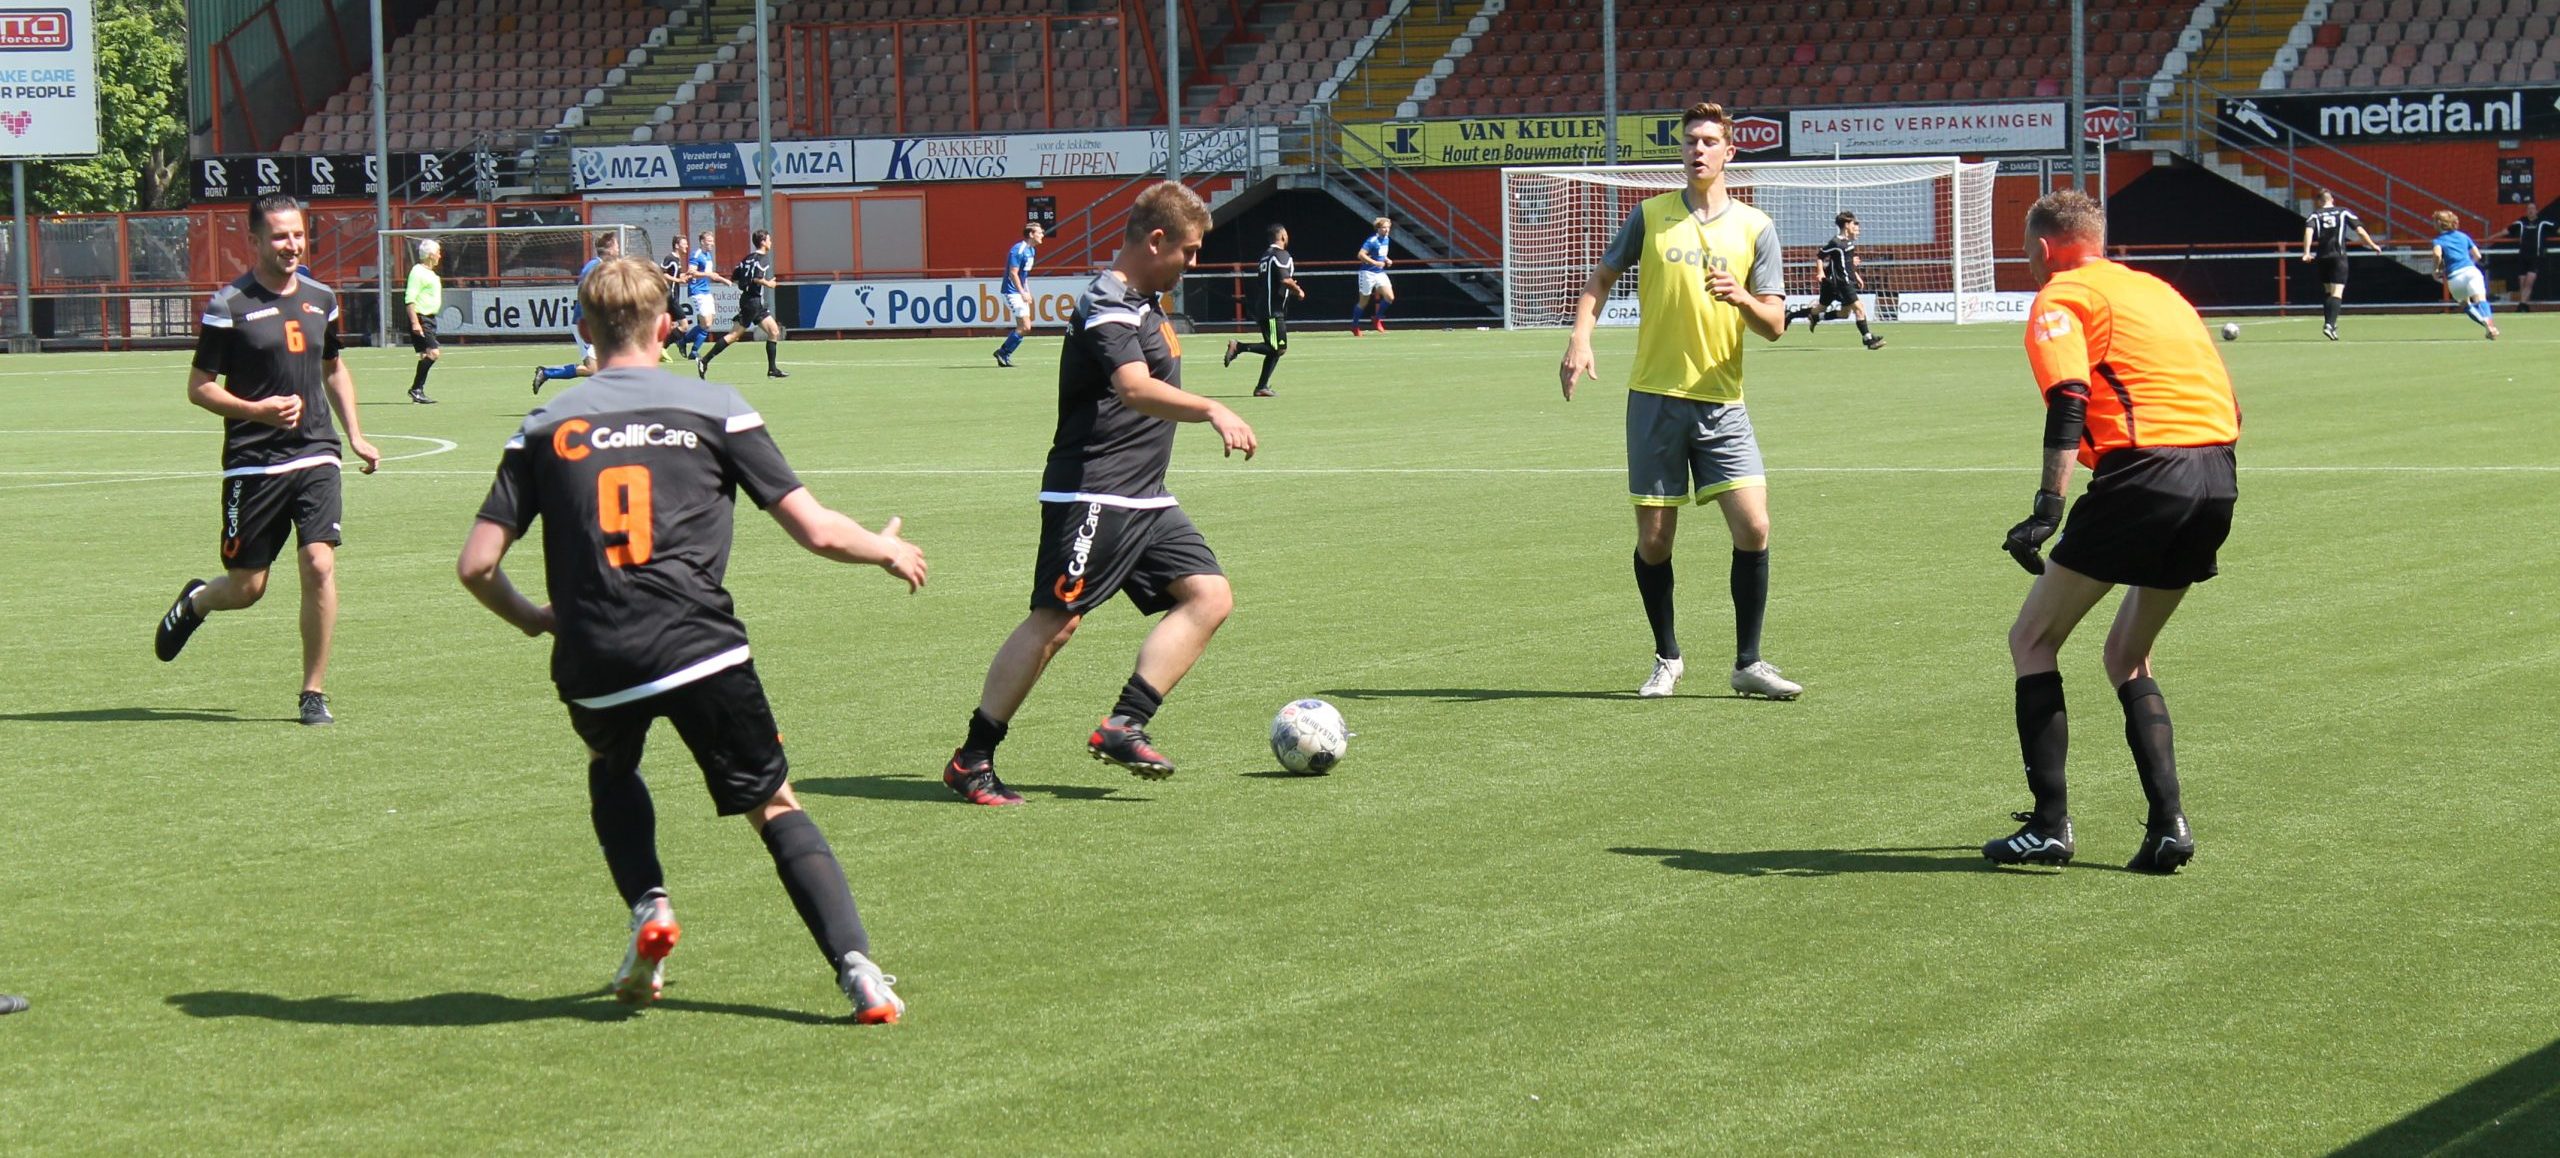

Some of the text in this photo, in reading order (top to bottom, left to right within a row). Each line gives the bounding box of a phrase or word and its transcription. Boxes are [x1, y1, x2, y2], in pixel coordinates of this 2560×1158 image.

[31, 69, 75, 82] CARE
[16, 85, 76, 99] PEOPLE
[1801, 113, 2053, 133] PLASTIC VERPAKKINGEN
[2320, 91, 2522, 136] metafa.nl
[1149, 131, 1248, 149] VOENDAM
[1459, 121, 1505, 141] VAN
[682, 151, 732, 161] Verzekerd van
[927, 139, 1007, 157] BAKKERIJ
[1055, 140, 1065, 150] de
[1442, 141, 1632, 163] Hout en Bouwmateriaen
[611, 156, 668, 179] MZA
[686, 160, 704, 172] goed
[785, 151, 844, 174] MZA
[882, 139, 1009, 181] KONINGS
[1039, 151, 1120, 176] FLIPPEN
[2009, 160, 2038, 171] DAMES
[204, 187, 228, 197] ROBEY
[311, 184, 335, 194] ROBEY
[1665, 247, 1728, 272] odin
[484, 297, 521, 328] de
[888, 283, 1075, 324] Podobrce
[1968, 300, 2025, 313] CIRCLE
[284, 320, 306, 353] 6
[590, 424, 698, 449] ColliCare
[228, 479, 243, 538] ColliCare
[598, 464, 653, 568] 9
[1068, 502, 1101, 577] ColliCare
